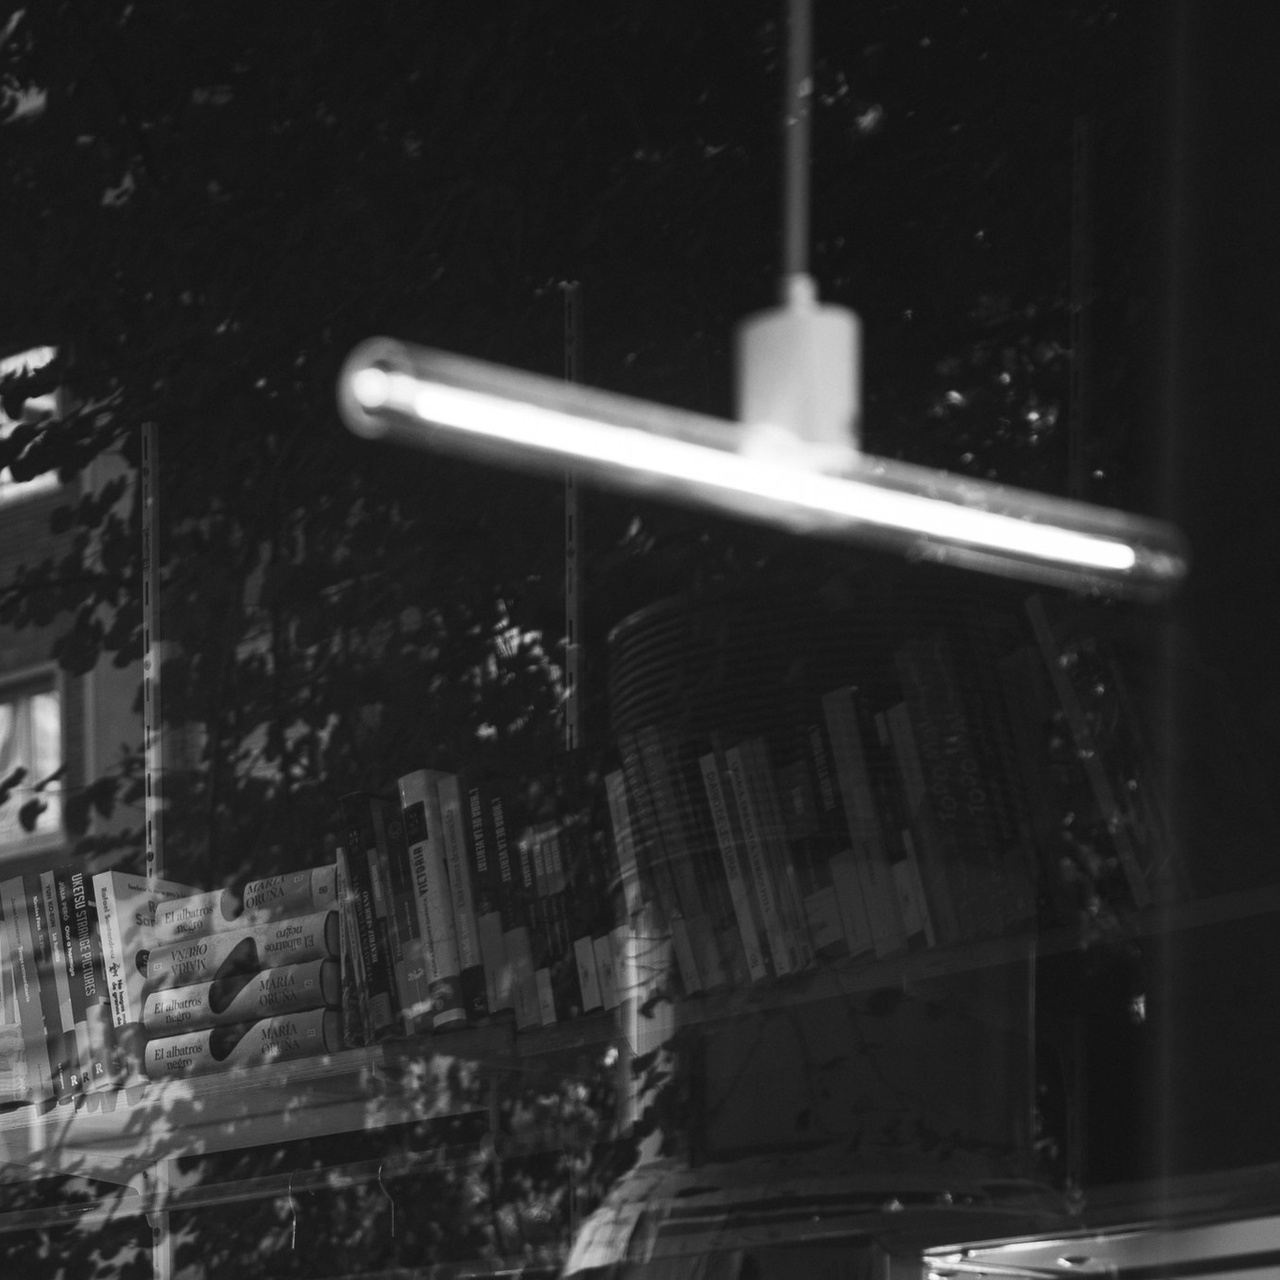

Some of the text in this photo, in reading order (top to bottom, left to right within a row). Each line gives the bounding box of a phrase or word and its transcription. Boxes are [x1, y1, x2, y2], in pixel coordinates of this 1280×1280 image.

[468, 788, 481, 817] L'HORA
[474, 842, 487, 872] VERITAT
[412, 845, 428, 896] VICTORIA
[498, 851, 511, 882] VERITAT
[247, 876, 284, 894] MARÍA
[246, 889, 284, 908] ORUÑA
[165, 907, 213, 924] El albatros
[71, 873, 96, 997] UKETSU STRANGE PICTURES
[176, 921, 203, 934] negro
[276, 926, 303, 938] negro
[265, 937, 300, 952] albatros
[259, 974, 295, 991] MARÍA
[154, 998, 202, 1014] El albatros
[260, 990, 296, 1006] ORUÑA
[165, 1012, 191, 1024] negro
[261, 1022, 297, 1040] MARÍA
[154, 1044, 202, 1060] El albatros
[166, 1058, 192, 1071] negro
